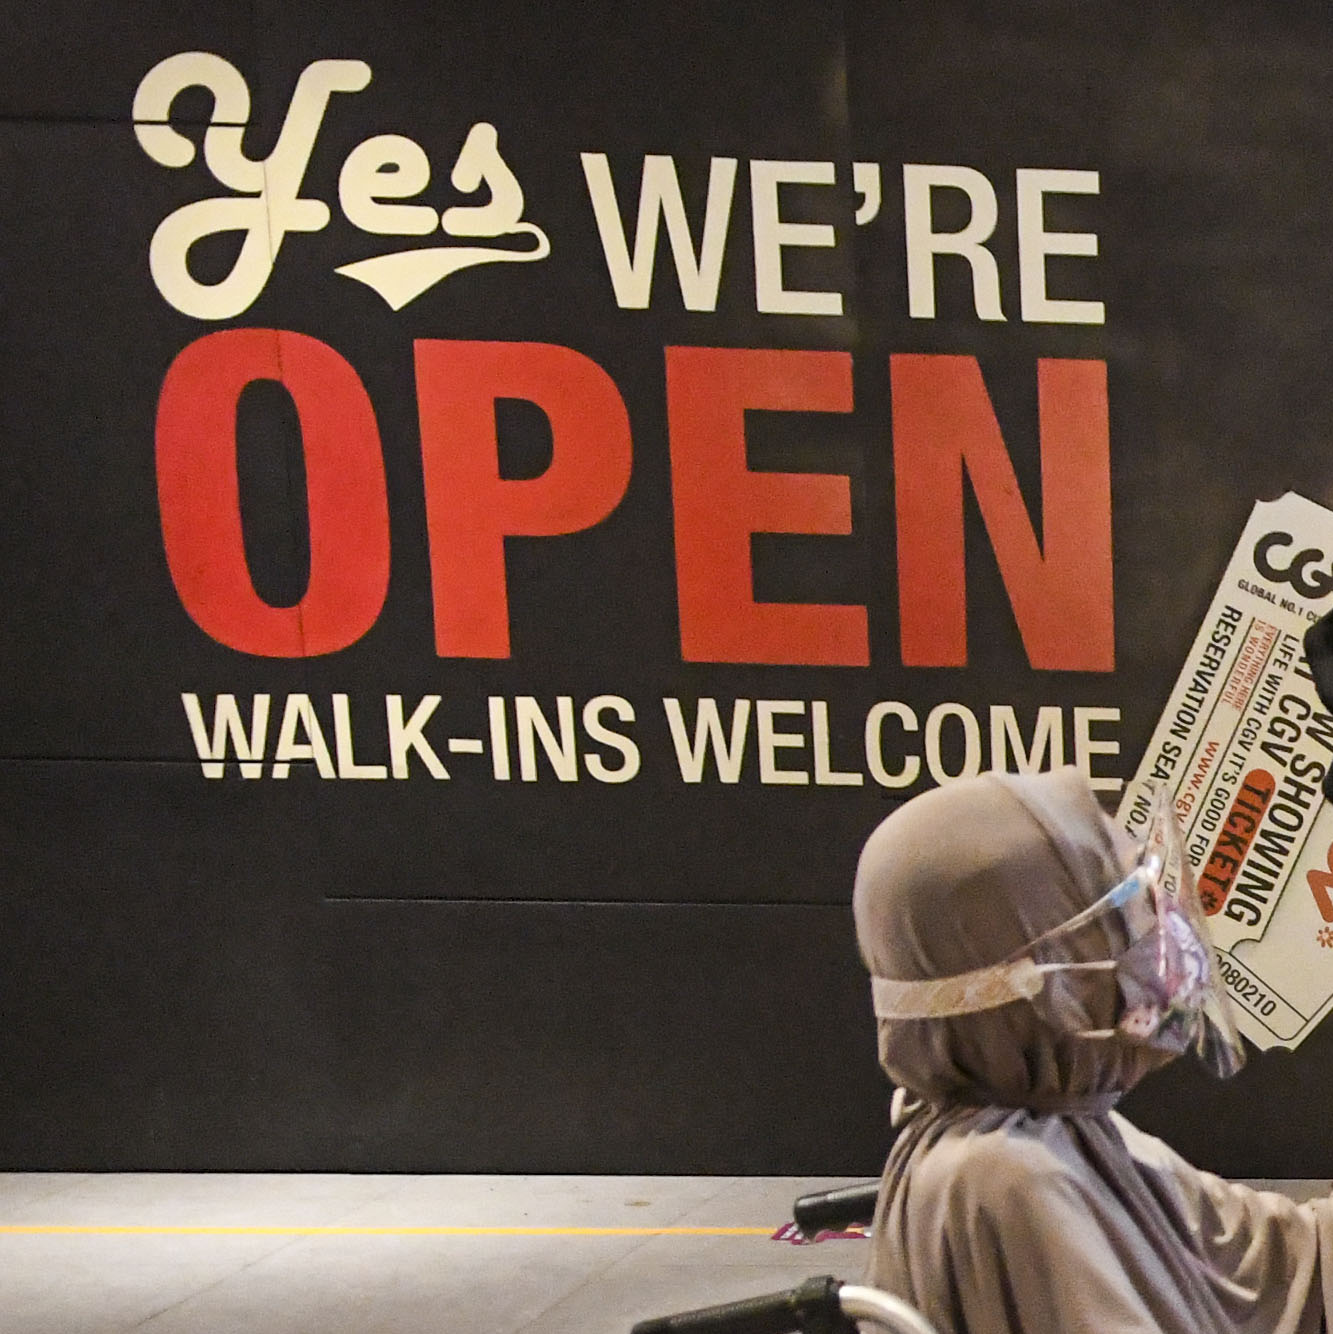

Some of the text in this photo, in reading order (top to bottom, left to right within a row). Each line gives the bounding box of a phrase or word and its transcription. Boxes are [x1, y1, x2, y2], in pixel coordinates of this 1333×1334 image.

[132, 50, 1105, 324] Yes WE'RE
[154, 326, 1115, 672] OPEN
[1237, 578, 1277, 606] GLOBAL
[1169, 604, 1243, 741] RESERVATION
[1221, 636, 1259, 705] WONDERFUL
[1272, 633, 1300, 672] LIFE
[1253, 673, 1283, 716] WITH
[181, 691, 1126, 791] WALK-INS WELCOME
[1237, 717, 1263, 751] CGV
[1259, 694, 1311, 768] CGV
[1221, 752, 1247, 786] IT'S
[1200, 786, 1232, 833] GOOD
[1201, 783, 1271, 893] TICKET
[1223, 753, 1326, 927] SHOWING
